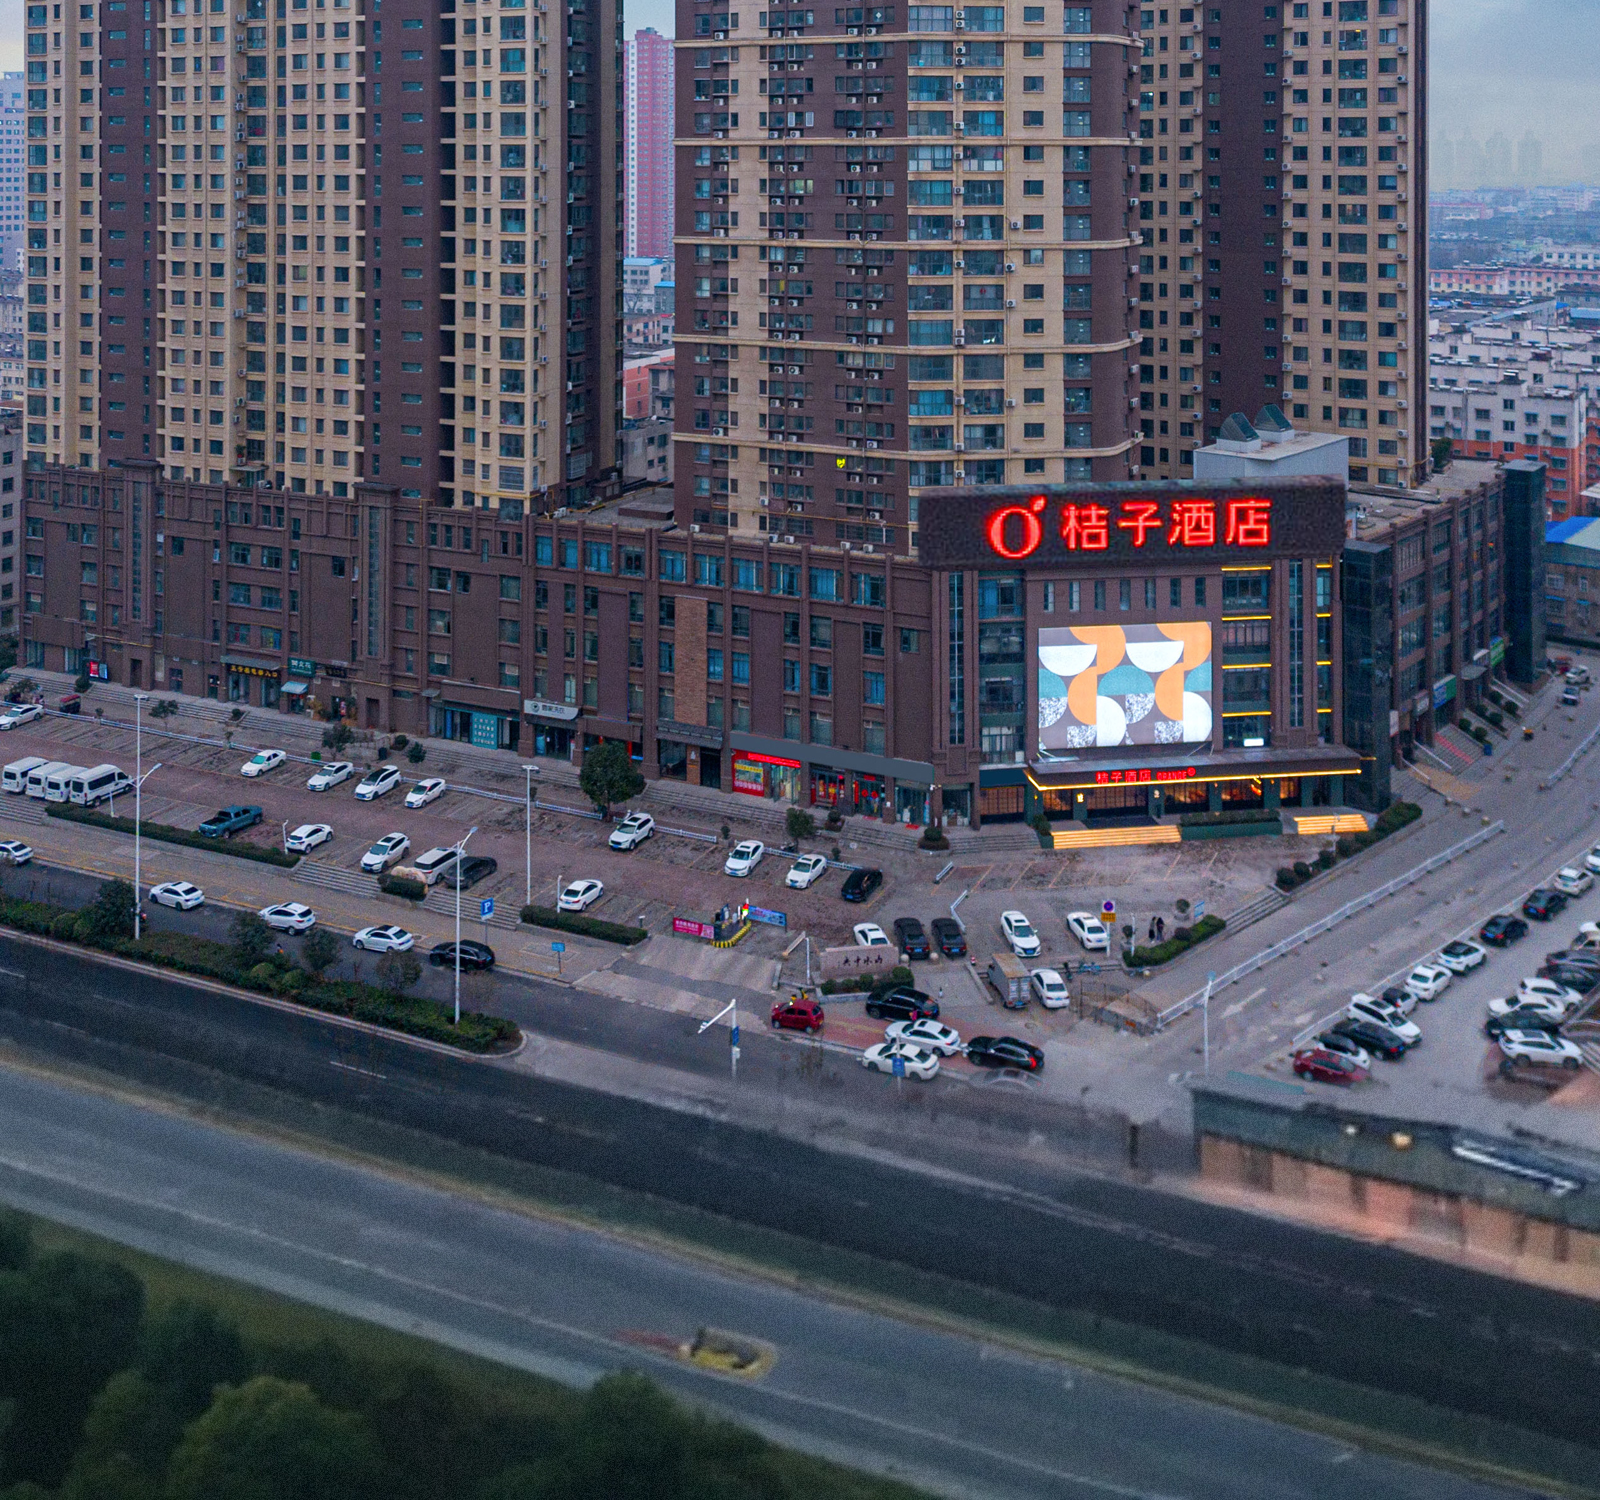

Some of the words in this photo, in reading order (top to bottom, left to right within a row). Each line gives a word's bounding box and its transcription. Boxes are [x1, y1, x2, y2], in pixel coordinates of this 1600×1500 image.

[1061, 498, 1273, 551] 桔子酒店
[1095, 769, 1152, 784] 桔子酒店
[1156, 770, 1187, 781] ORANGE
